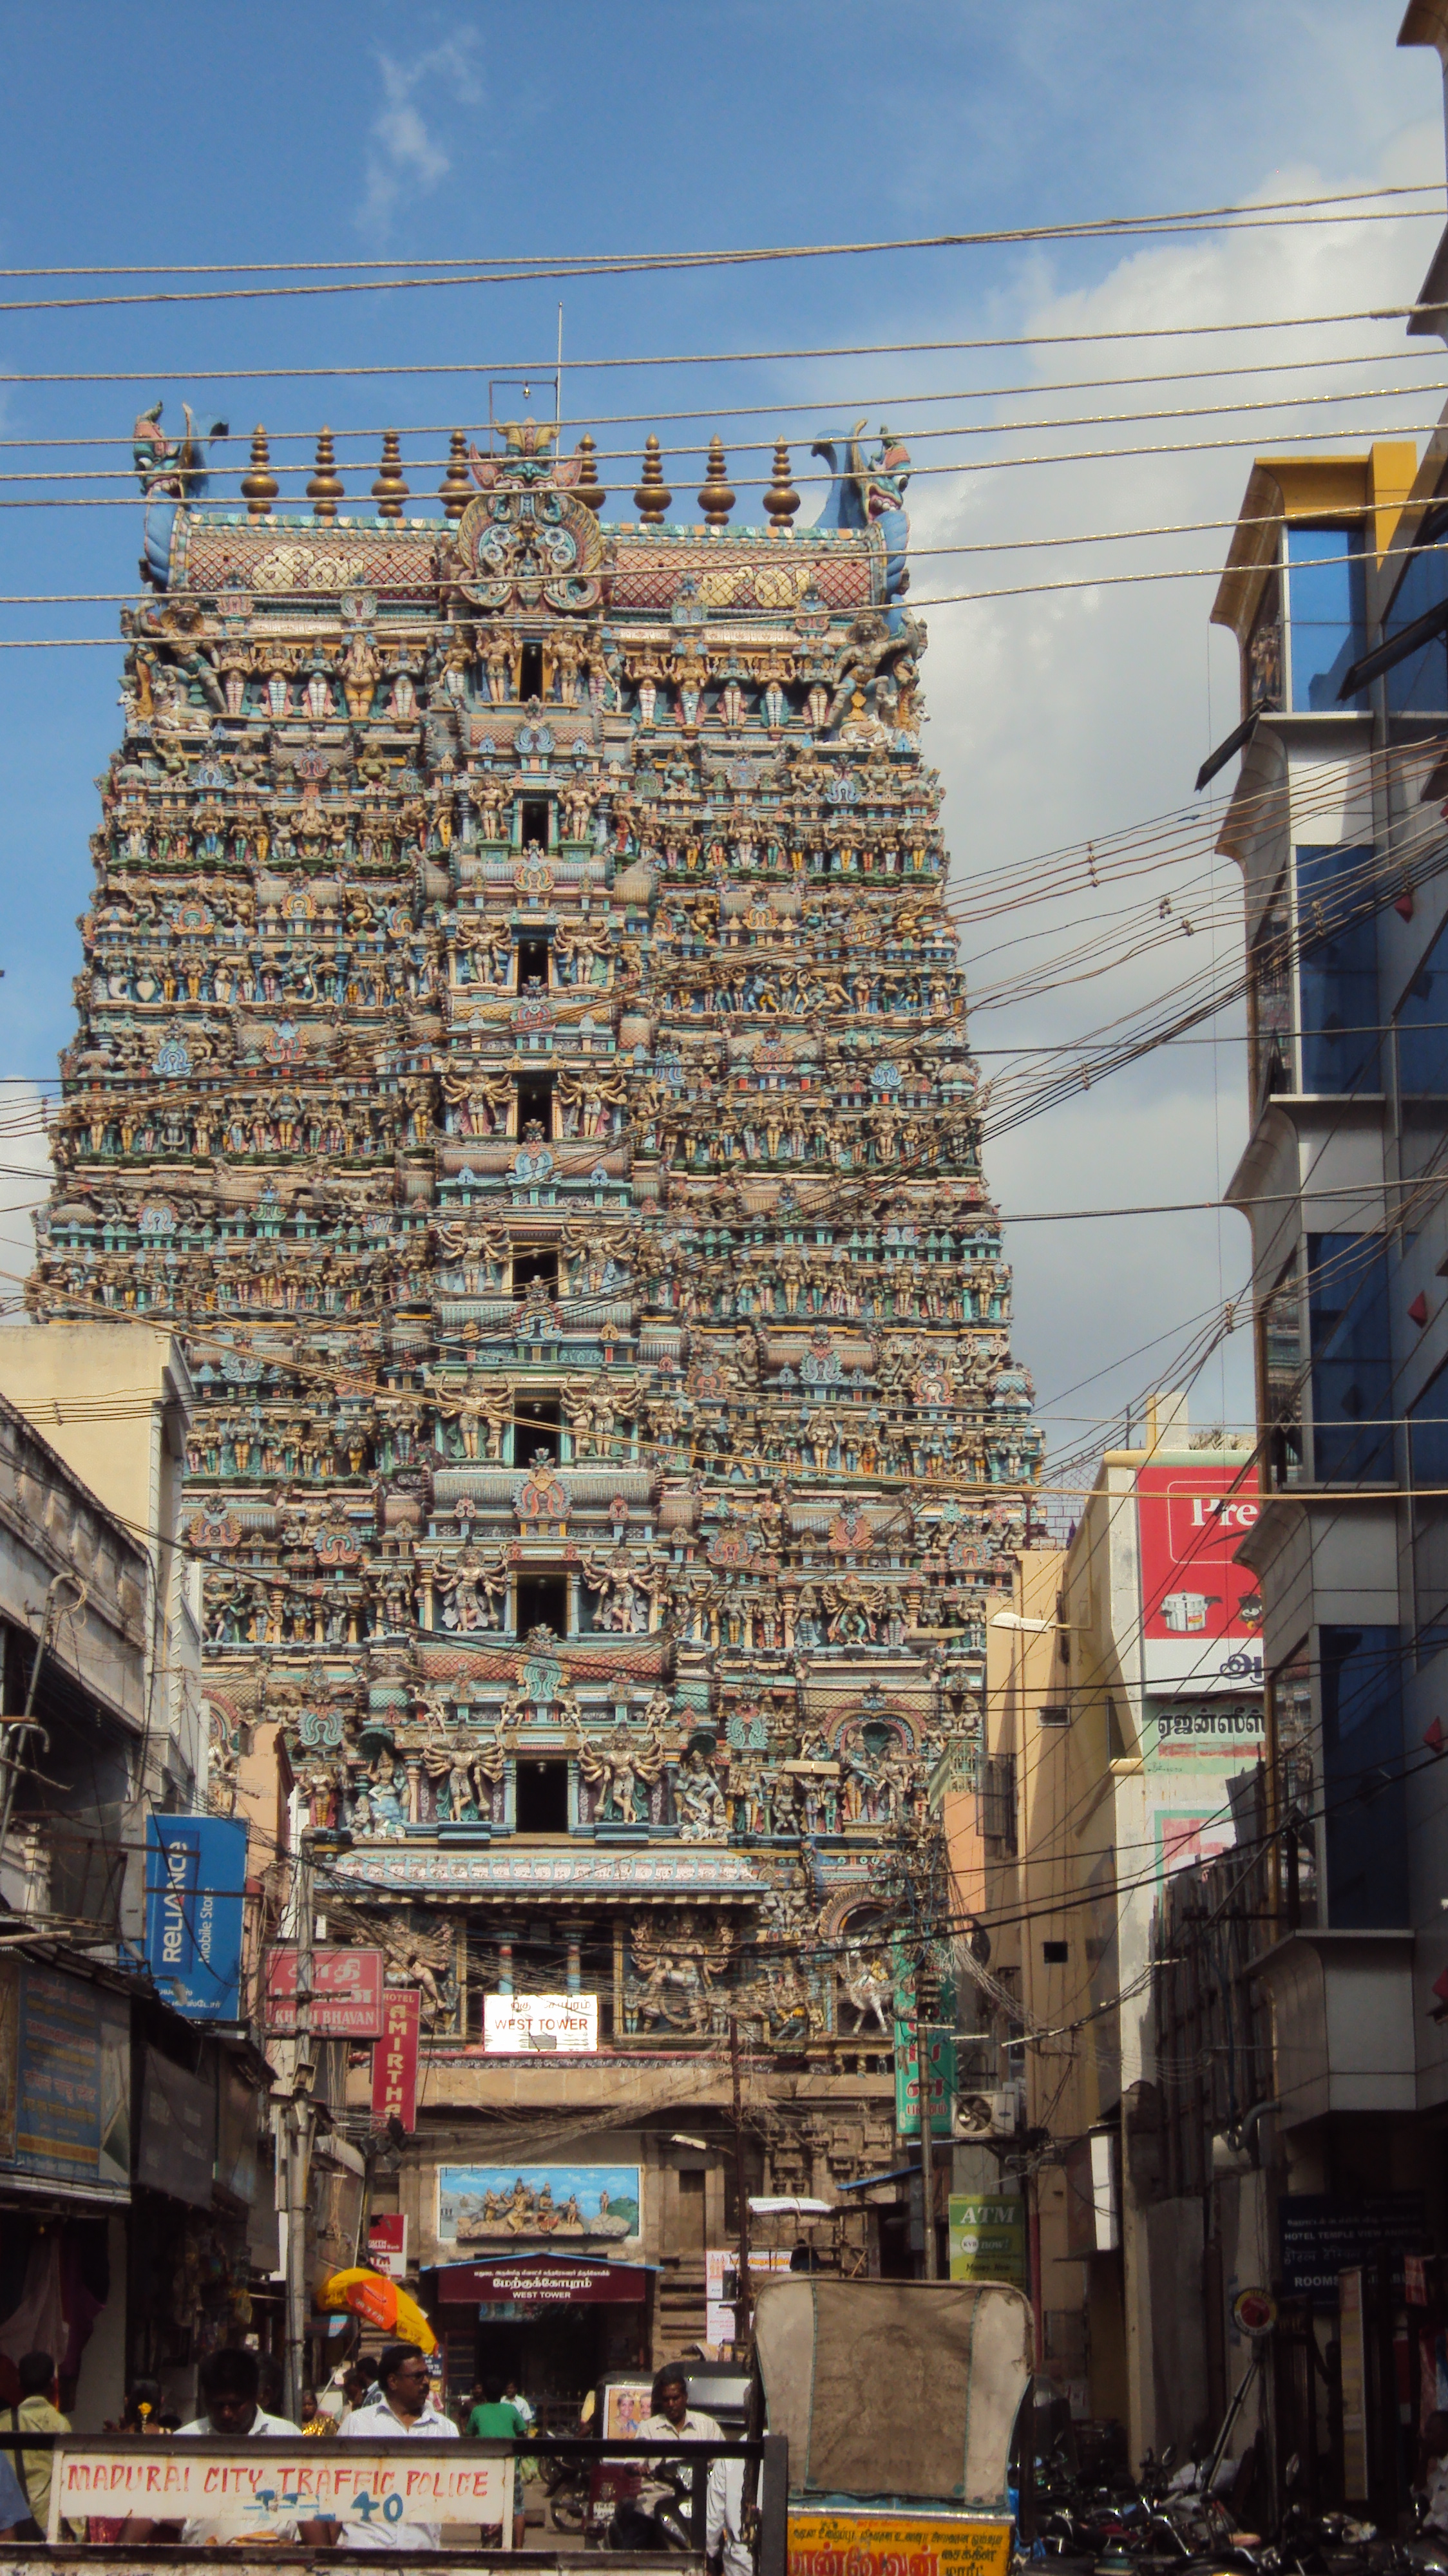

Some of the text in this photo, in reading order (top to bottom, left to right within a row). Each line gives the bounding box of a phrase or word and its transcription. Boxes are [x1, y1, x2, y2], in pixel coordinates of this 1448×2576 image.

[1192, 1499, 1258, 1526] Pre
[198, 1922, 212, 1964] Mobile
[384, 1994, 414, 2003] HOTEL
[275, 2010, 374, 2025] KHI BHAVAN
[495, 2019, 588, 2030] WEST TOWER
[960, 2206, 1015, 2224] ATM
[1284, 2231, 1315, 2240] HOTEL
[1318, 2230, 1355, 2240] TEMPLE
[1357, 2230, 1382, 2239] VIEW
[68, 2465, 488, 2497] MADURAI CITY TRAFFIC POLICE
